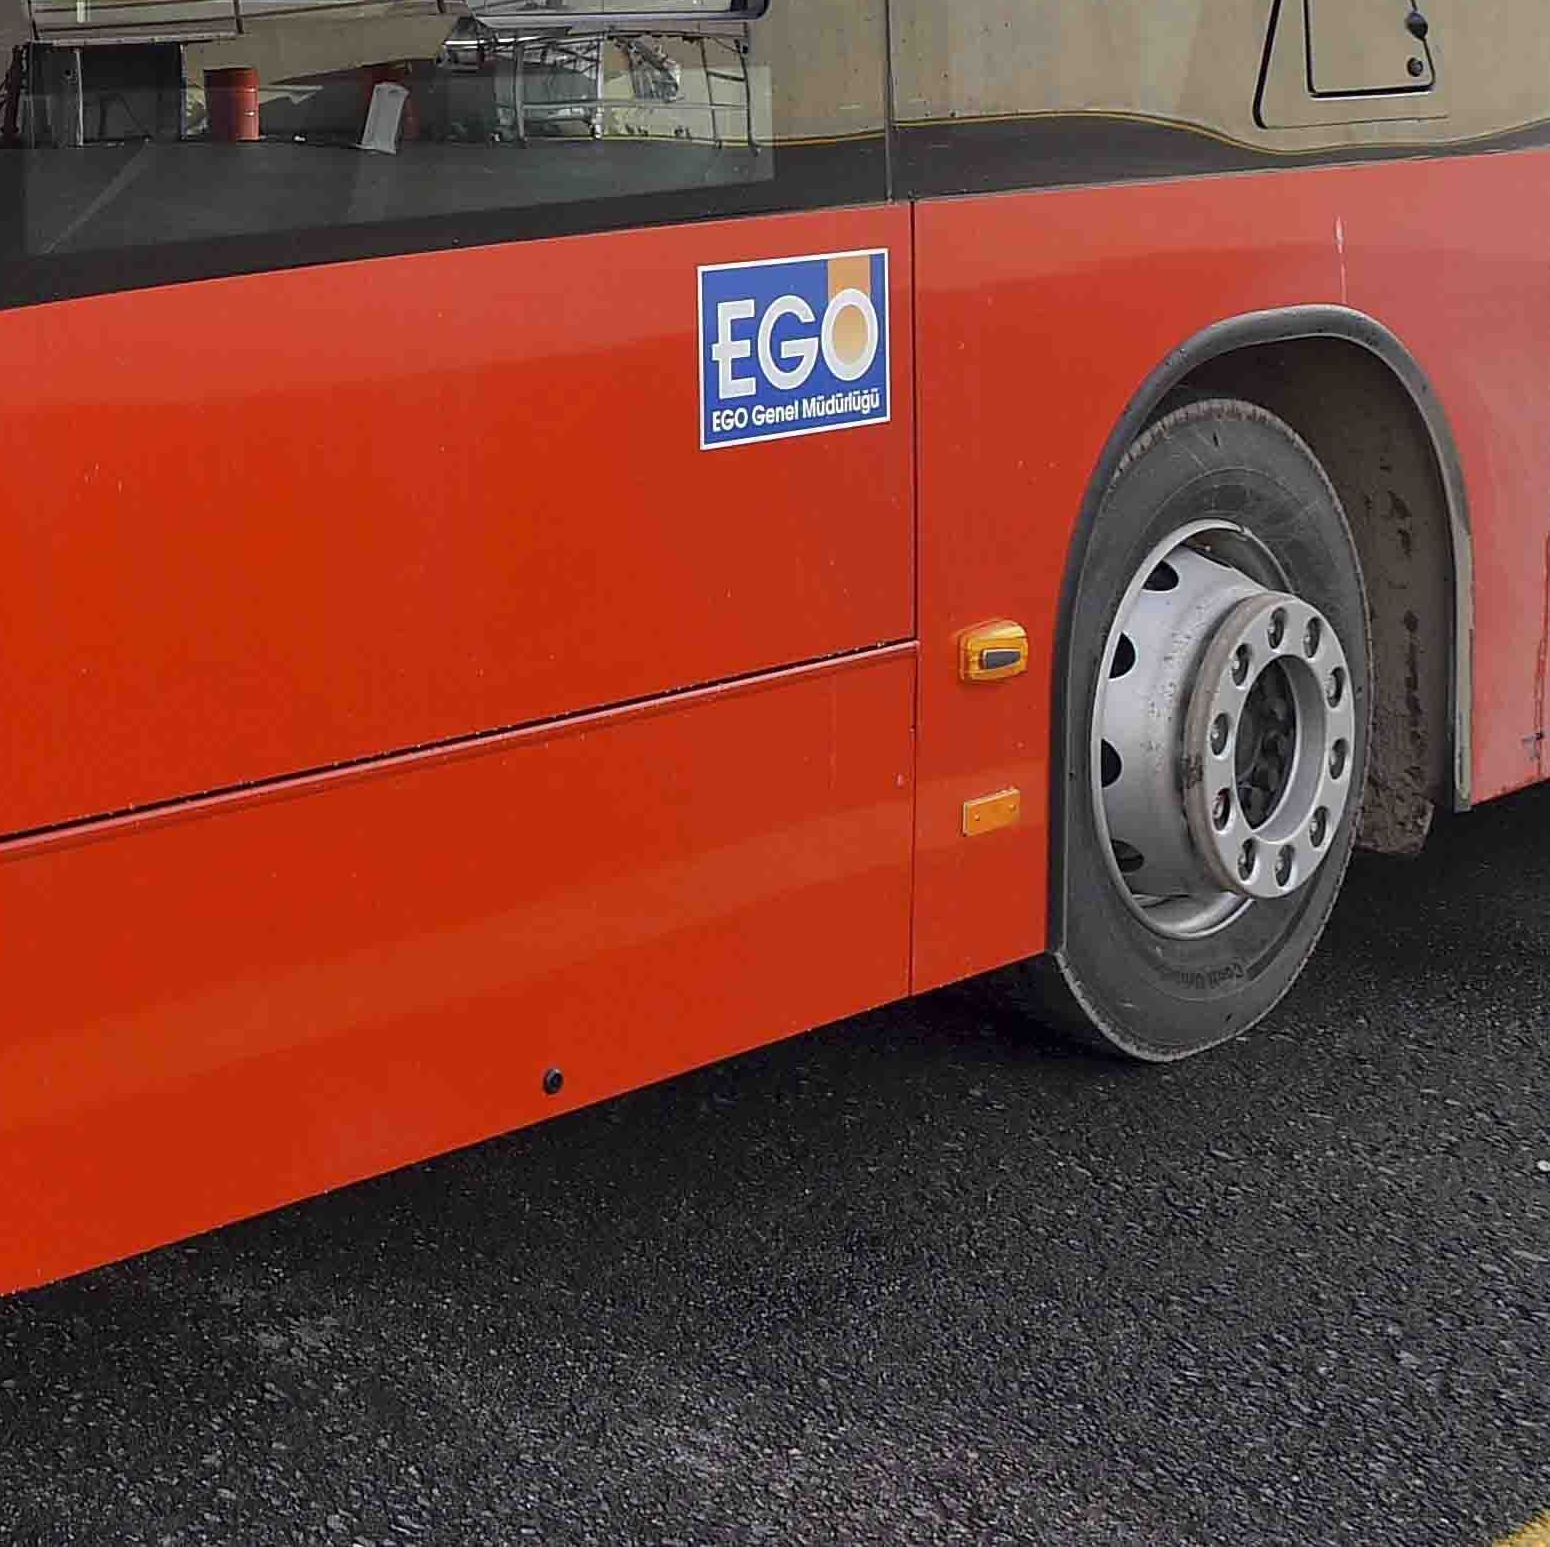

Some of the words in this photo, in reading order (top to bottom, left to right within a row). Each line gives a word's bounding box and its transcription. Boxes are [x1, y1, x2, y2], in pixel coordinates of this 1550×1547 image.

[712, 289, 879, 399] EGO
[712, 407, 749, 433] EGO
[752, 399, 799, 427] Genel
[803, 388, 881, 419] Müdürlüğü
